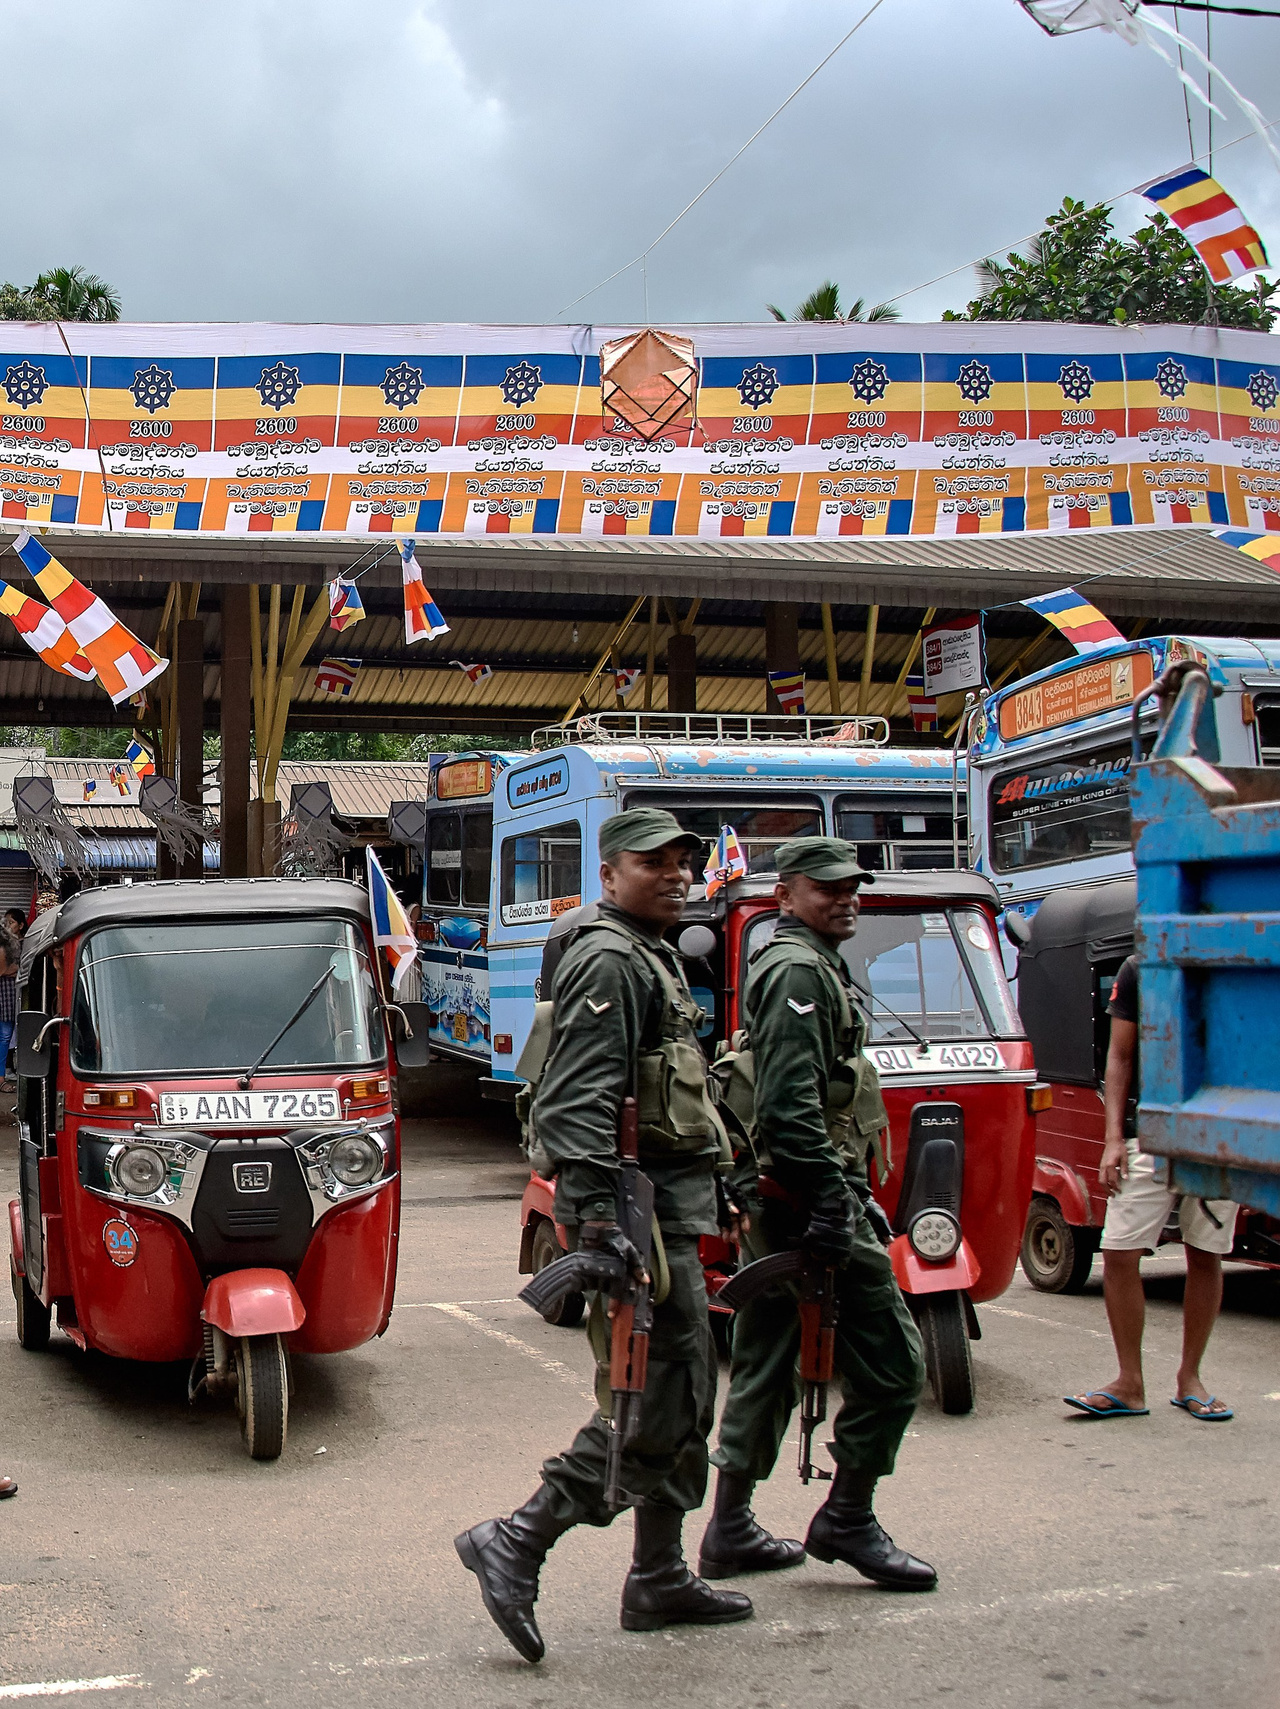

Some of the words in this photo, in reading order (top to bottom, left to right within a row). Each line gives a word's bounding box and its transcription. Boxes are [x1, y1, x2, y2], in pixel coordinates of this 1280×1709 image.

[847, 411, 885, 427] 2600
[959, 411, 993, 426] 2600
[1062, 410, 1094, 424] 2600
[1158, 408, 1185, 421] 2600
[3, 416, 44, 432] 2600
[130, 421, 171, 438] 2600
[256, 417, 296, 435] 2600
[378, 417, 418, 434] 2600
[496, 415, 535, 432] 2600
[733, 415, 772, 432] 2600
[1046, 711, 1074, 724] DENIYAYA
[1012, 805, 1041, 817] SUPER
[1040, 800, 1060, 811] LINE
[1063, 796, 1082, 805] THE
[1081, 789, 1105, 800] KING
[1104, 787, 1118, 796] OF
[874, 1049, 913, 1070] QU
[939, 1046, 999, 1067] 4029
[195, 1096, 253, 1120] AAN
[262, 1093, 336, 1119] 7265
[240, 1172, 265, 1187] RE
[108, 1230, 133, 1249] 34
